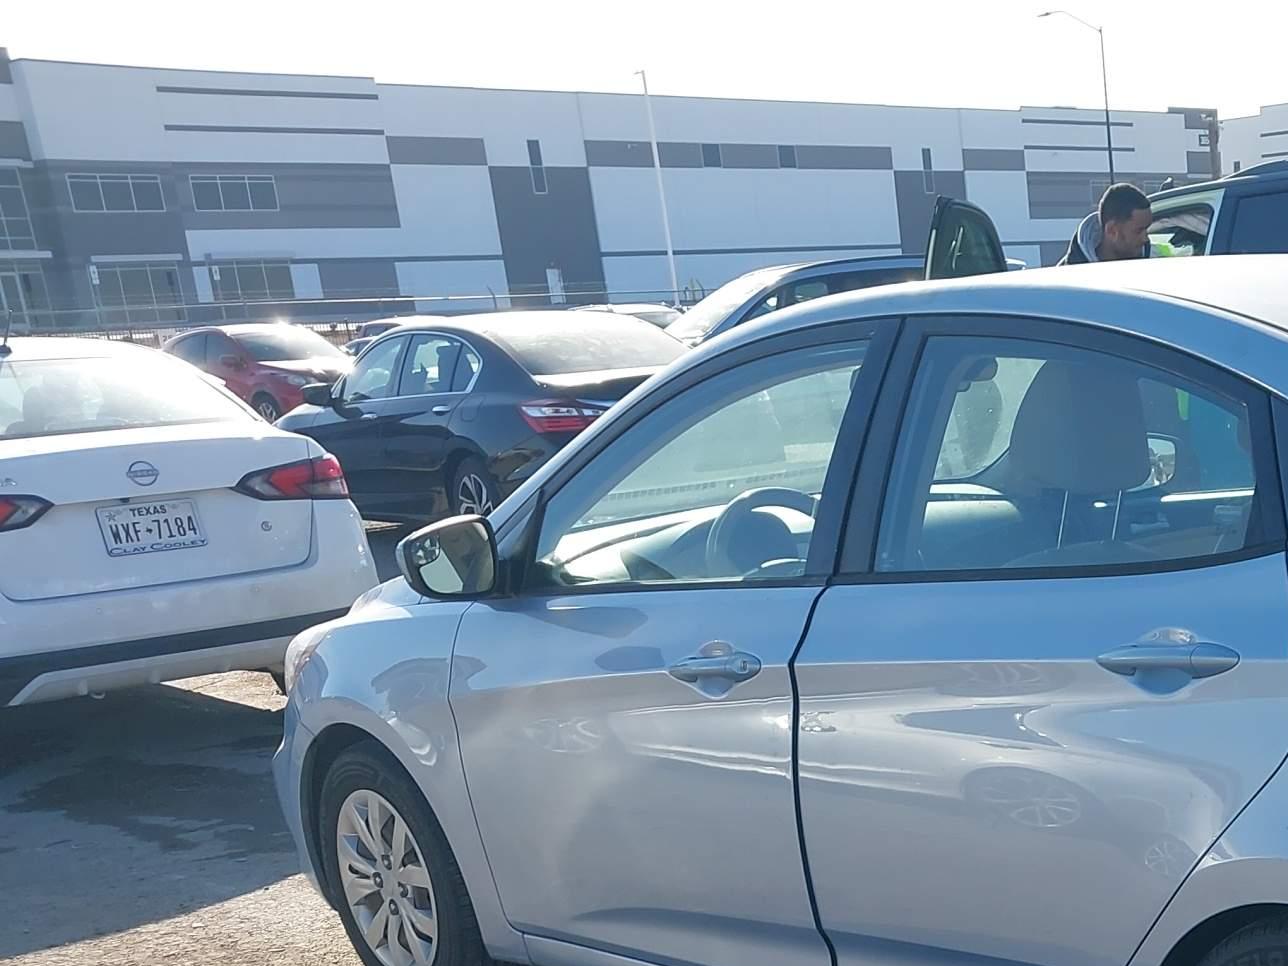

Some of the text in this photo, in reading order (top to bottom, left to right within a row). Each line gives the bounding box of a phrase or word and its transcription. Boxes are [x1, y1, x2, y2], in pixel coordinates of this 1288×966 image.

[129, 505, 167, 518] TEXAS
[110, 538, 207, 555] CLAY COOLEY
